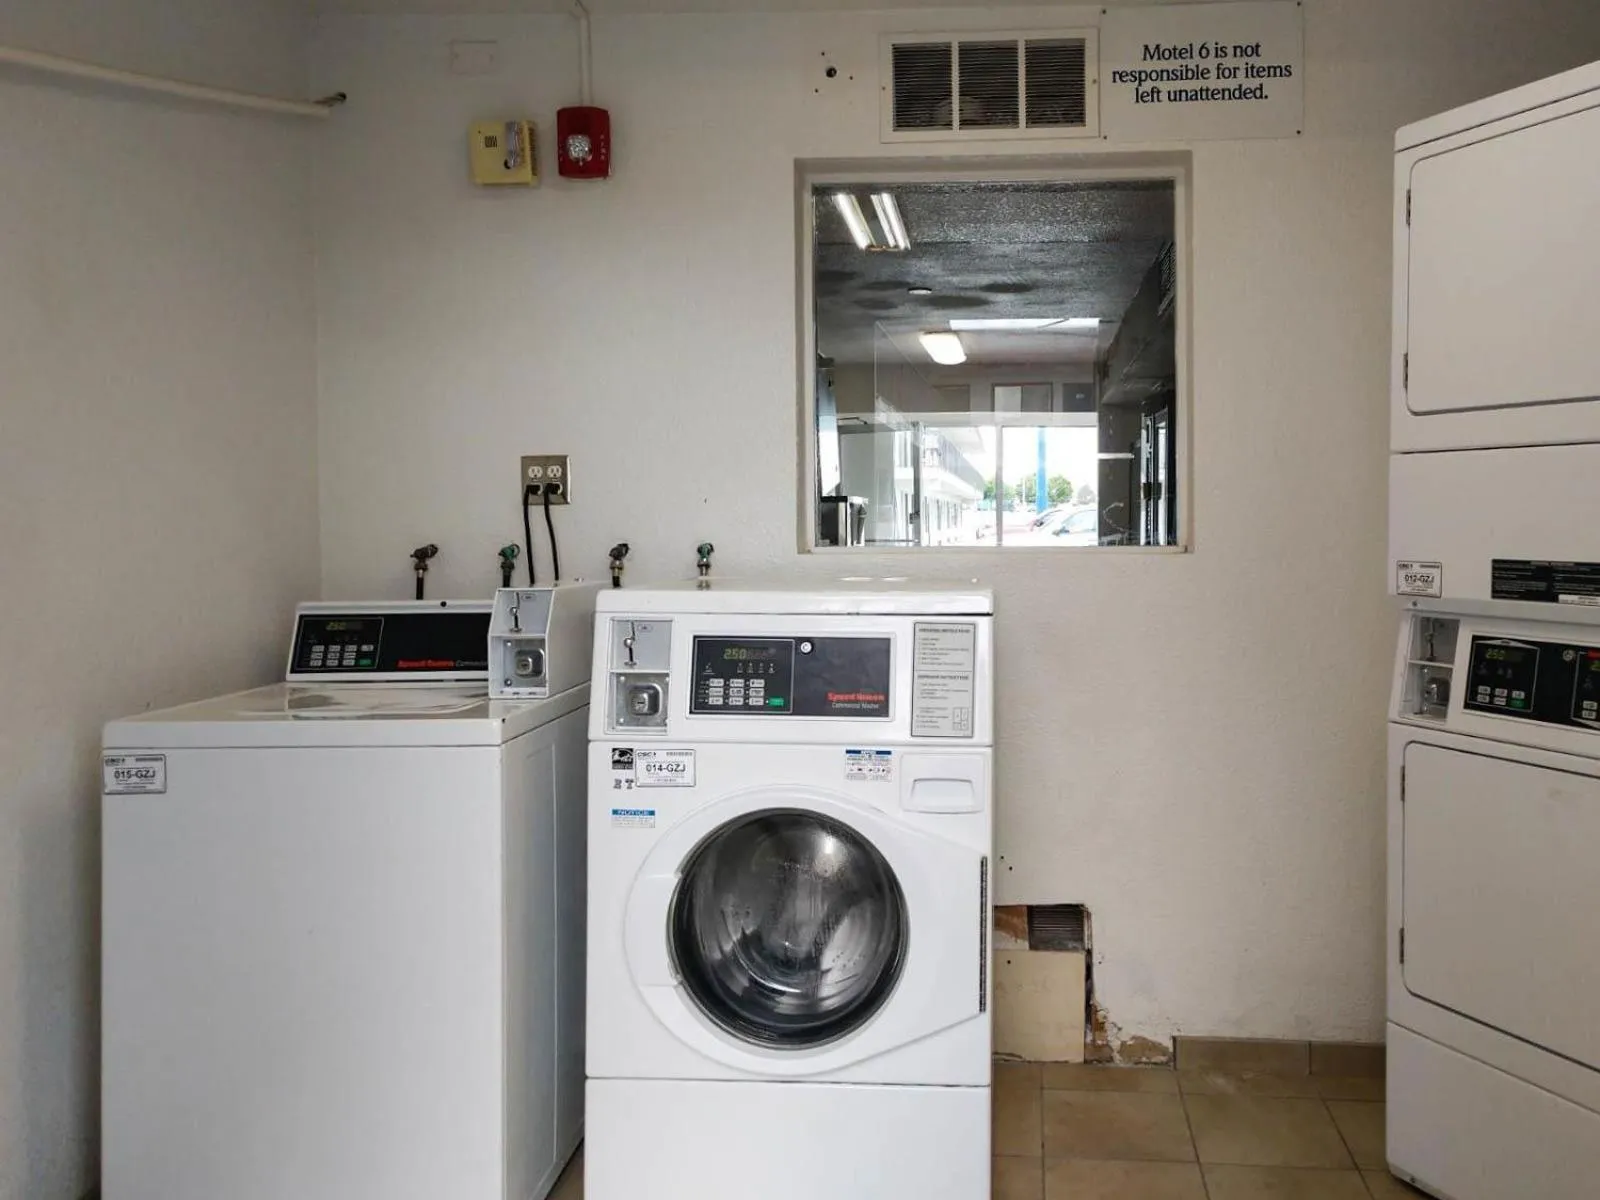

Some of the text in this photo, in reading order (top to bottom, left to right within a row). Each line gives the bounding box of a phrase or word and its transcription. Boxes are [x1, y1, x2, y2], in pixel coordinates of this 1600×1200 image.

[1143, 42, 1261, 61] Motel 6 is not
[1112, 62, 1292, 86] responsible for items
[1135, 83, 1268, 103] left unattended.
[723, 648, 747, 660] 250
[114, 769, 156, 779] 015-GZJ
[645, 763, 686, 773] 014-GZJ
